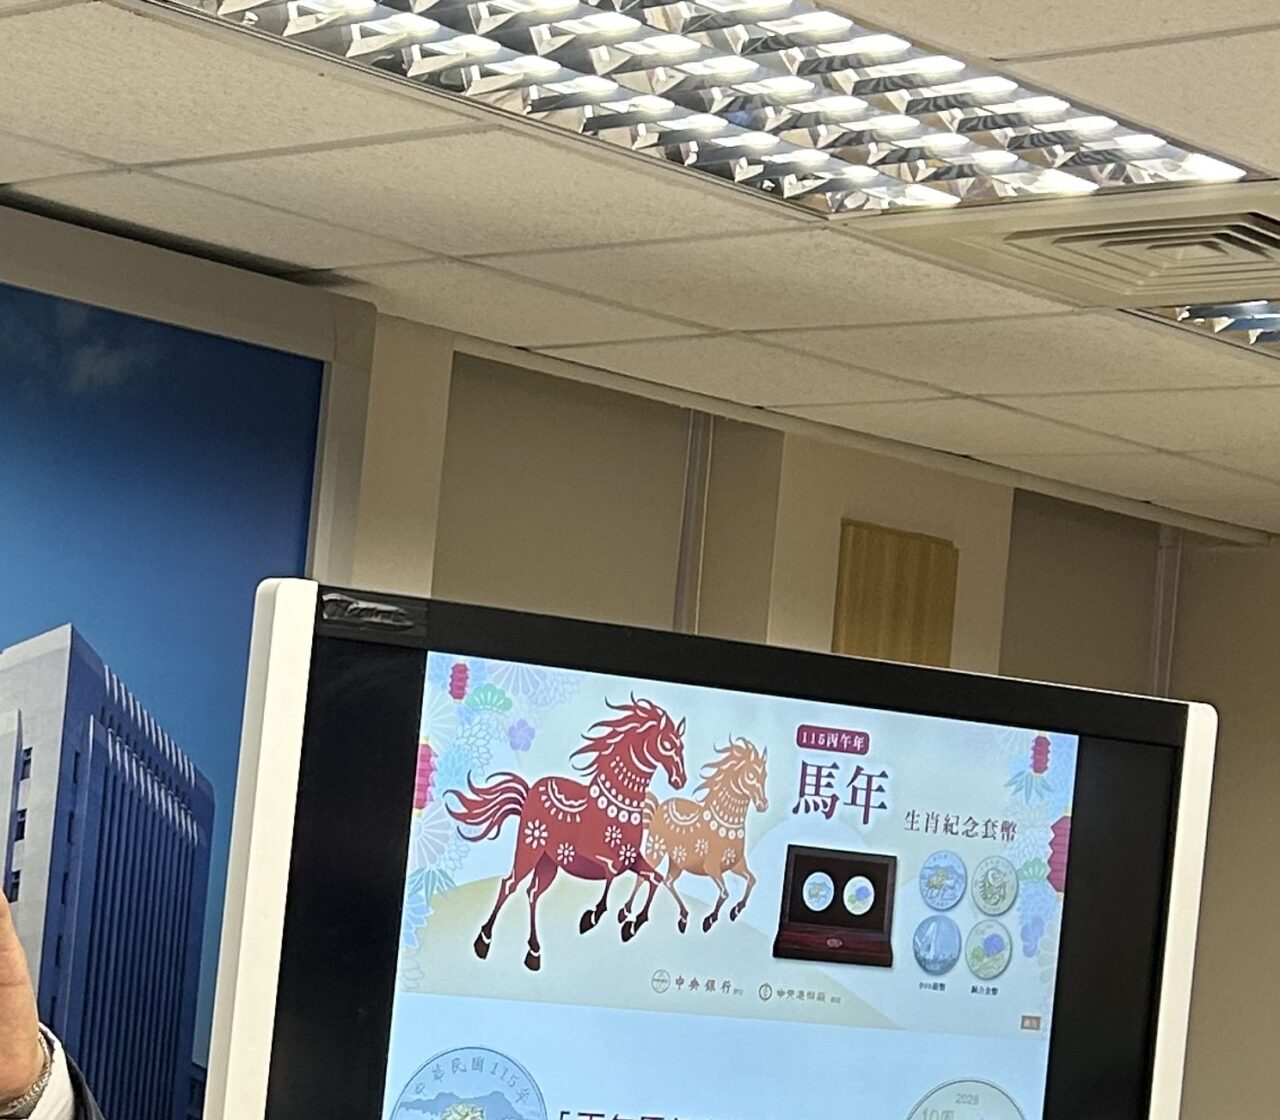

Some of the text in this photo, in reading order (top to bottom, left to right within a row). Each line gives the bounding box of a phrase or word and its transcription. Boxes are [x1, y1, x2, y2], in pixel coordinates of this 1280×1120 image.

[801, 731, 865, 752] 115丙午年
[792, 760, 889, 825] 馬年
[904, 809, 1018, 842] 生肖紀念套幣
[675, 975, 732, 994] 中央銀行
